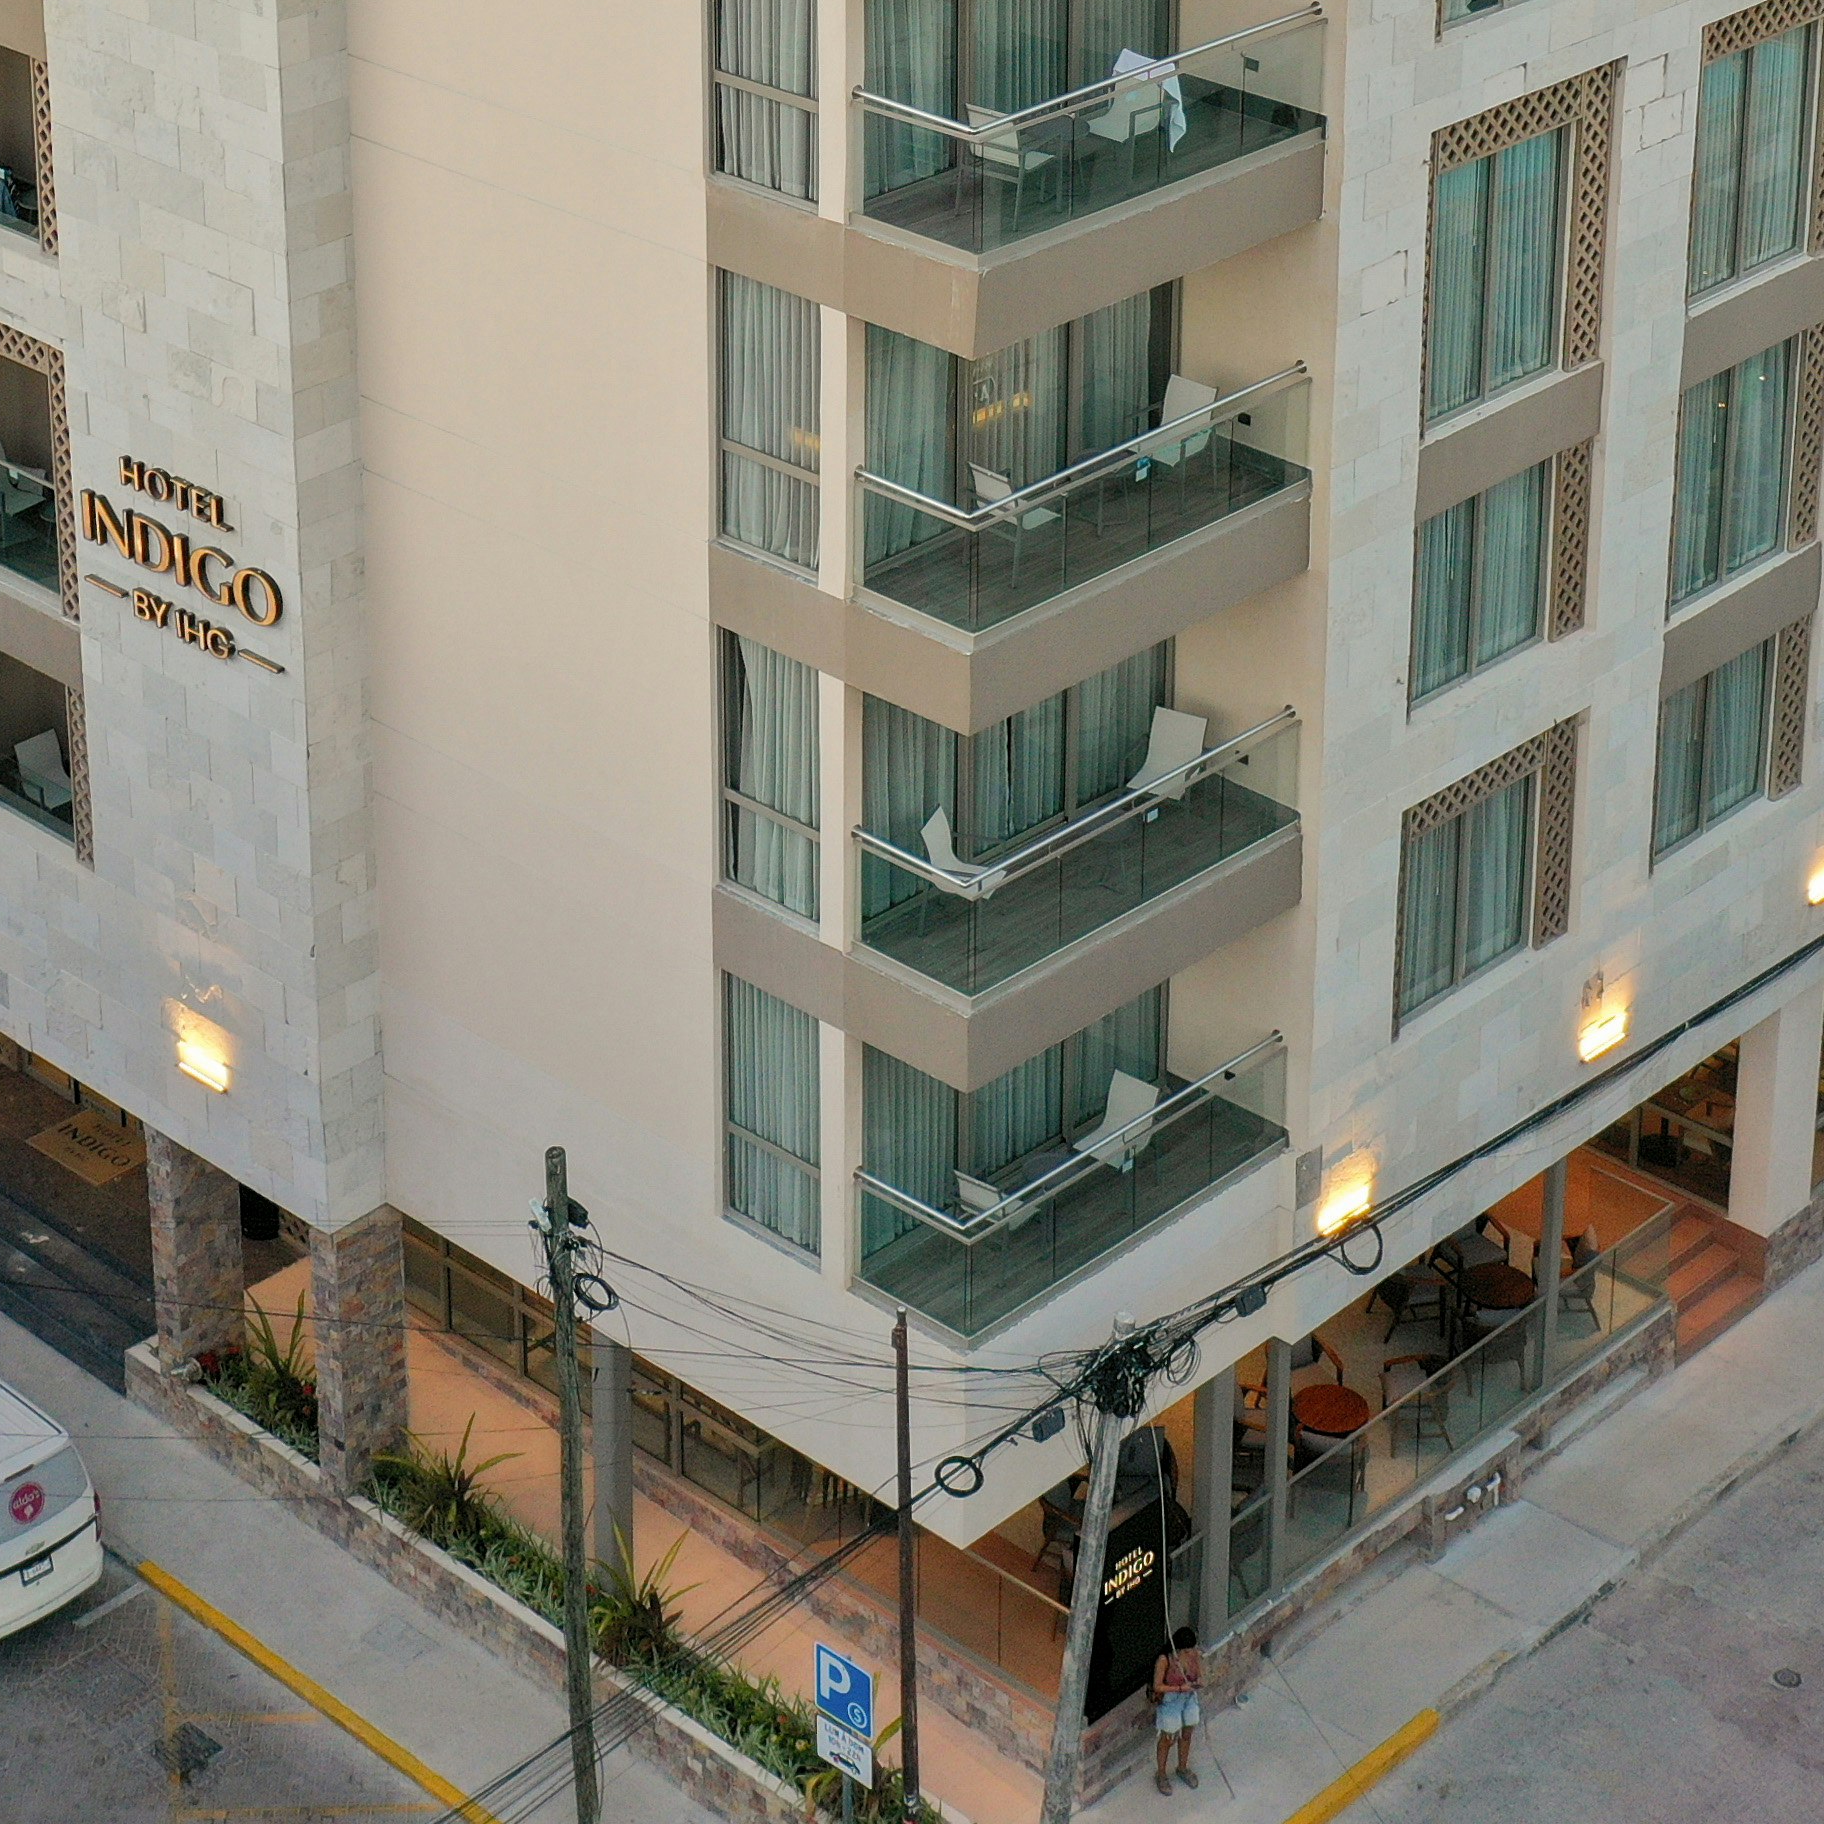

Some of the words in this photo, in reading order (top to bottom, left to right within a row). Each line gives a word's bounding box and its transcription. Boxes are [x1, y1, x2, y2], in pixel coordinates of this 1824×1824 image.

[119, 455, 234, 533] HOTEL
[80, 488, 284, 627] INDIGO
[133, 587, 173, 629] BY
[175, 608, 236, 661] IHG
[58, 1123, 131, 1167] INDIGO
[1104, 1550, 1154, 1596] INDIGO
[820, 1650, 851, 1700] P
